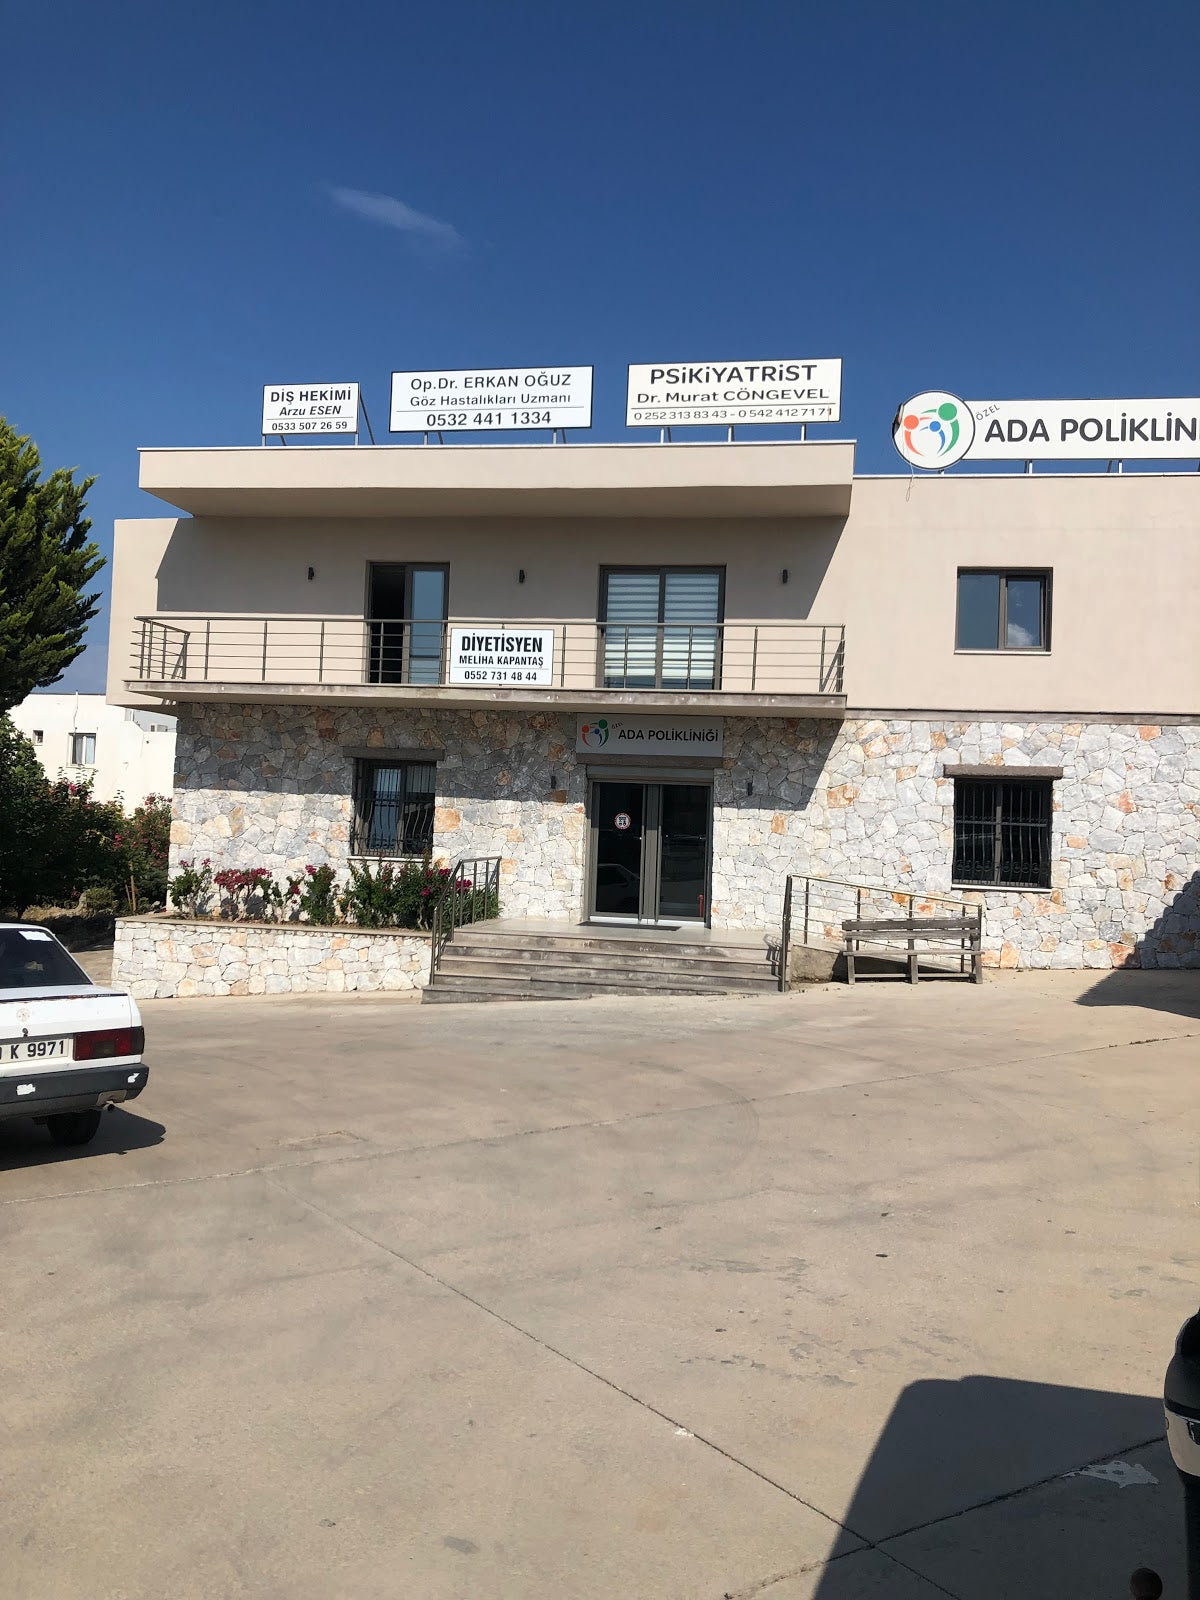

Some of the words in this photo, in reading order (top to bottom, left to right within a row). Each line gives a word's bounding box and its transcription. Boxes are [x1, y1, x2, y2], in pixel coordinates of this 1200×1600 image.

[410, 377, 458, 392] Op.Dr.
[464, 375, 519, 389] ERKAN
[524, 371, 572, 387] OĞUZ
[271, 388, 294, 405] DİŞ
[299, 386, 351, 401] HEKİMİ
[410, 396, 436, 407] Göz
[440, 394, 516, 406] Hastalıkları
[521, 393, 571, 403] Uzmanı
[637, 393, 660, 403] Dr.
[666, 391, 719, 402] Murat
[724, 387, 830, 401] CÖNGEVEL
[279, 407, 306, 416] Arzu
[310, 405, 342, 415] ESEN
[426, 413, 467, 426] 0532
[473, 412, 502, 425] 441
[511, 411, 552, 424] 1334
[975, 404, 1000, 421] ÖZEL
[272, 422, 296, 431] 0533
[299, 422, 317, 430] 507
[320, 422, 332, 430] 26
[335, 421, 347, 429] 59
[984, 418, 1050, 443] ADA
[1060, 412, 1200, 442] POLİKLİN
[461, 633, 542, 652] DİYETİSYEN
[459, 653, 494, 664] MELİHA
[497, 656, 544, 669] KAPANTAŞ
[465, 671, 487, 680] 0552
[491, 672, 507, 680] 731
[511, 672, 523, 680] 48
[525, 672, 537, 681] 44
[618, 729, 644, 740] ADA
[648, 728, 719, 742] POLİKLİNİĞİ
[10, 1044, 19, 1060] K
[27, 1040, 64, 1057] 9971
